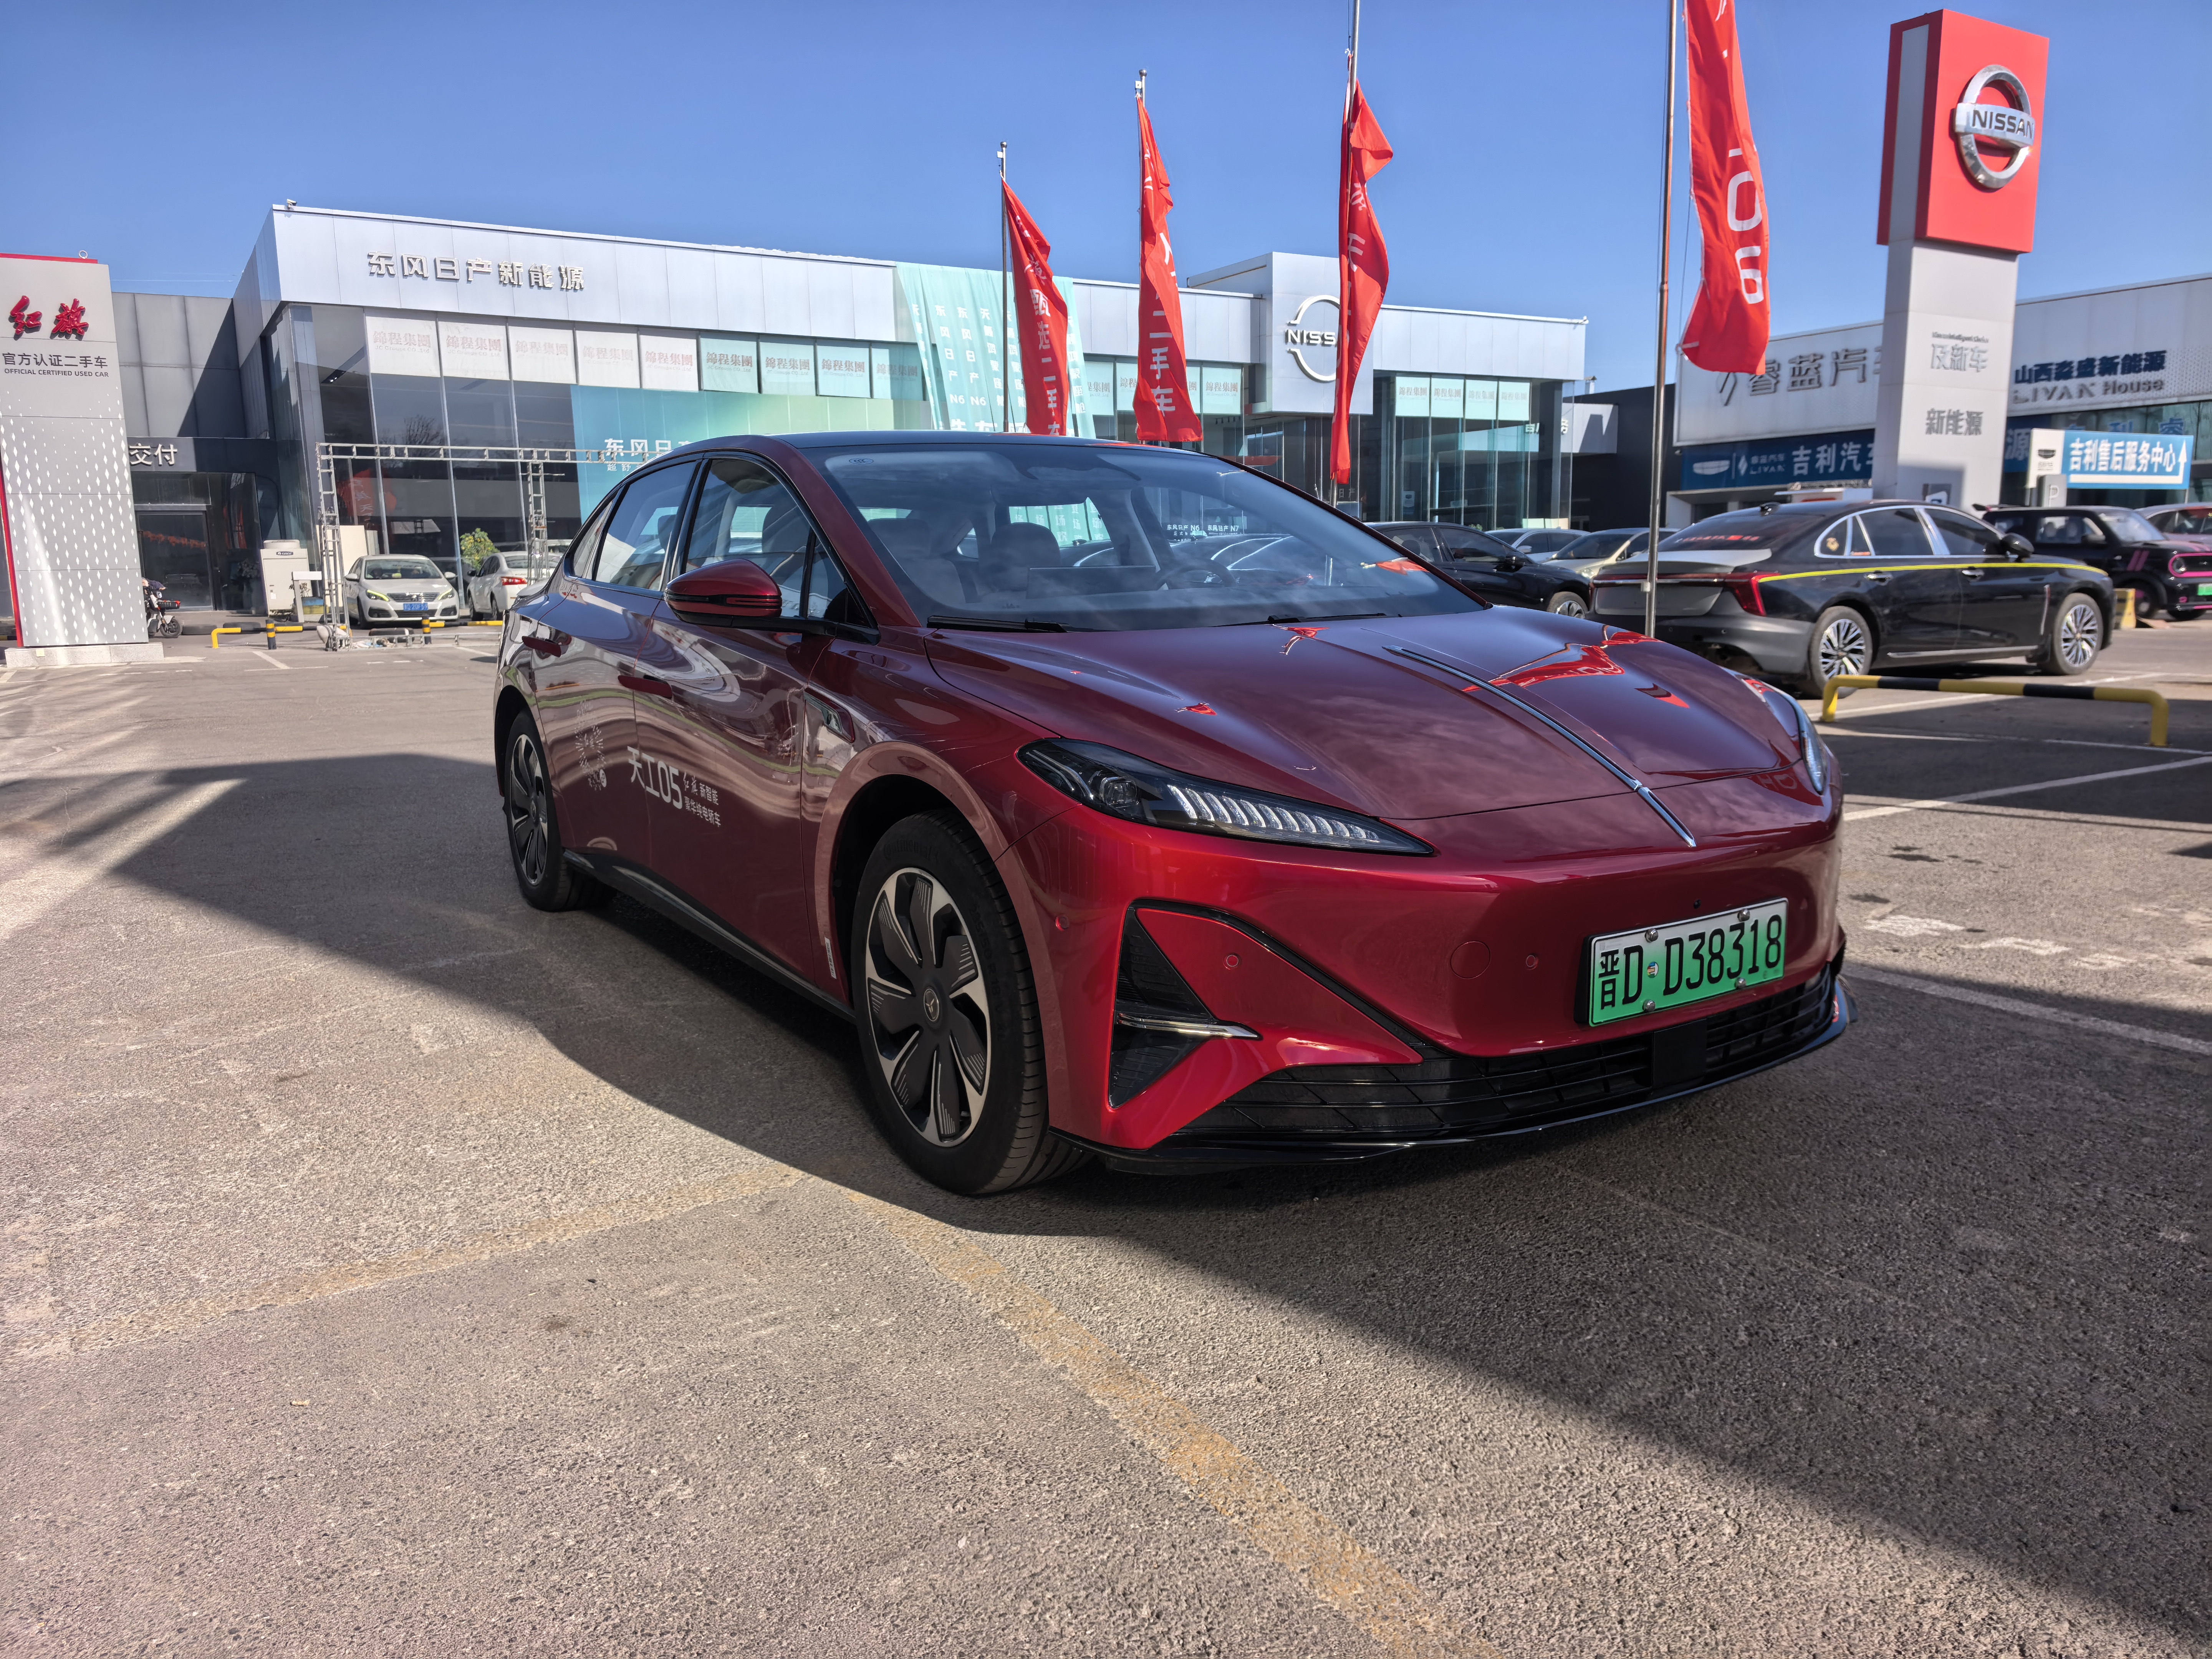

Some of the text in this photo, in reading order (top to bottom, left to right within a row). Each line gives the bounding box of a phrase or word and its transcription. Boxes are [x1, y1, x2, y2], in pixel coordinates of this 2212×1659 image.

[1972, 109, 2034, 140] NISSAN
[368, 250, 585, 290] 东风日产新能源
[10, 295, 89, 335] 红旗
[1285, 328, 1336, 346] NISS
[2, 353, 108, 368] 官方认证二手车
[1749, 347, 1883, 396] 睿蓝汽
[2103, 379, 2164, 396] House
[1926, 408, 1984, 436] 新能源
[129, 443, 178, 465] 交付
[604, 438, 692, 456] 东风日
[2068, 437, 2176, 474] 吉利售后服务中心
